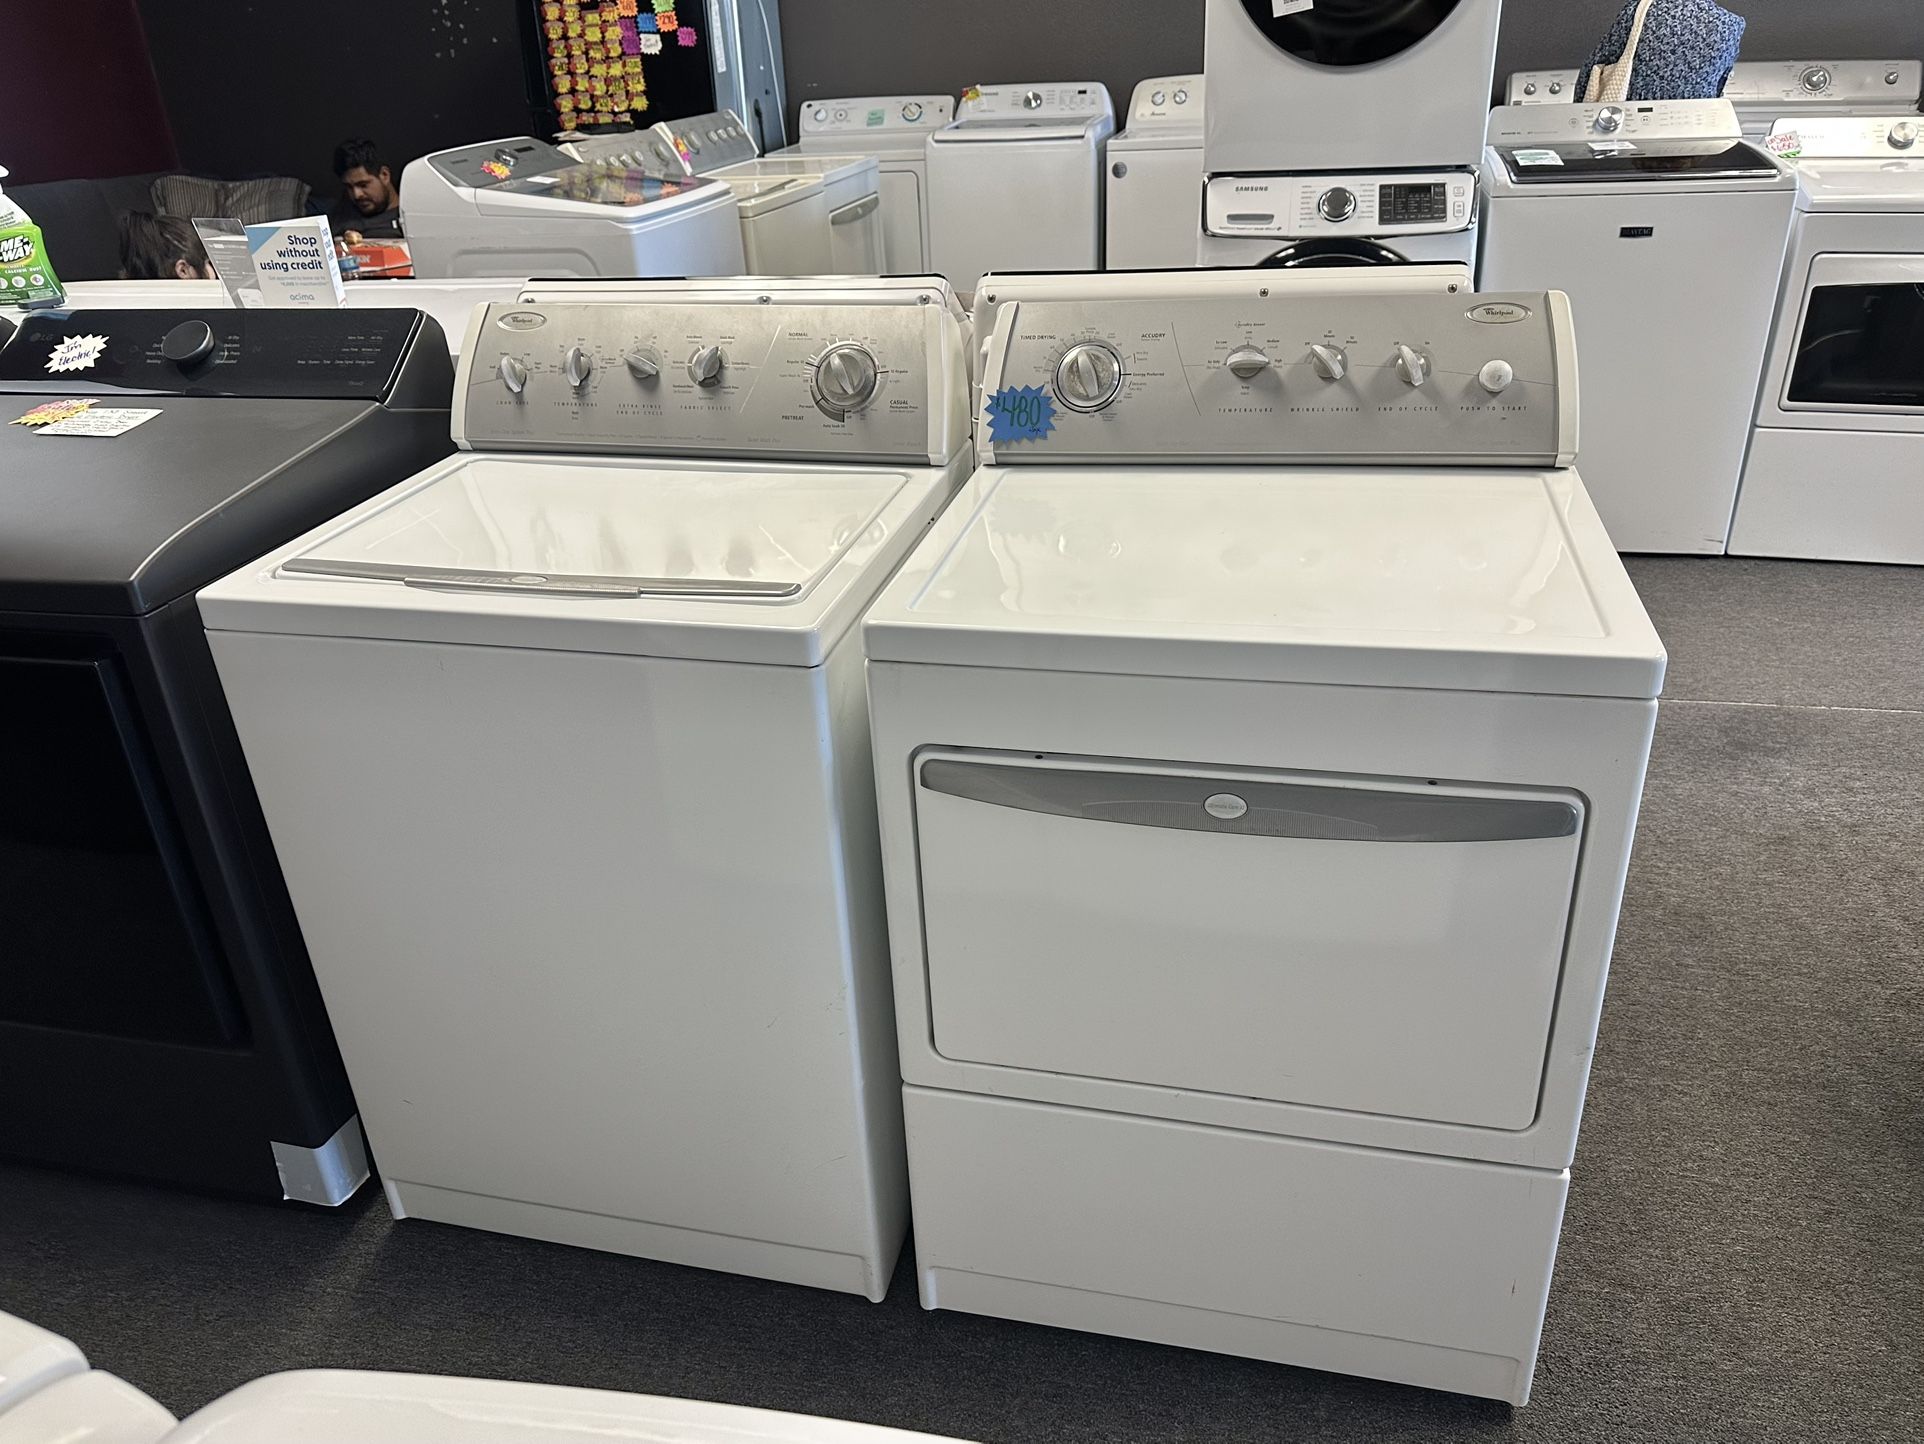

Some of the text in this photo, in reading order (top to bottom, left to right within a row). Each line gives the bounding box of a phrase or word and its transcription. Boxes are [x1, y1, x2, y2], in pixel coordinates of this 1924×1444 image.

[287, 235, 317, 247] Shop
[277, 248, 320, 258] without
[260, 261, 323, 273] using credit
[289, 293, 315, 301] acima
[1484, 307, 1514, 316] Whirlpool
[58, 346, 97, 366] Electric!
